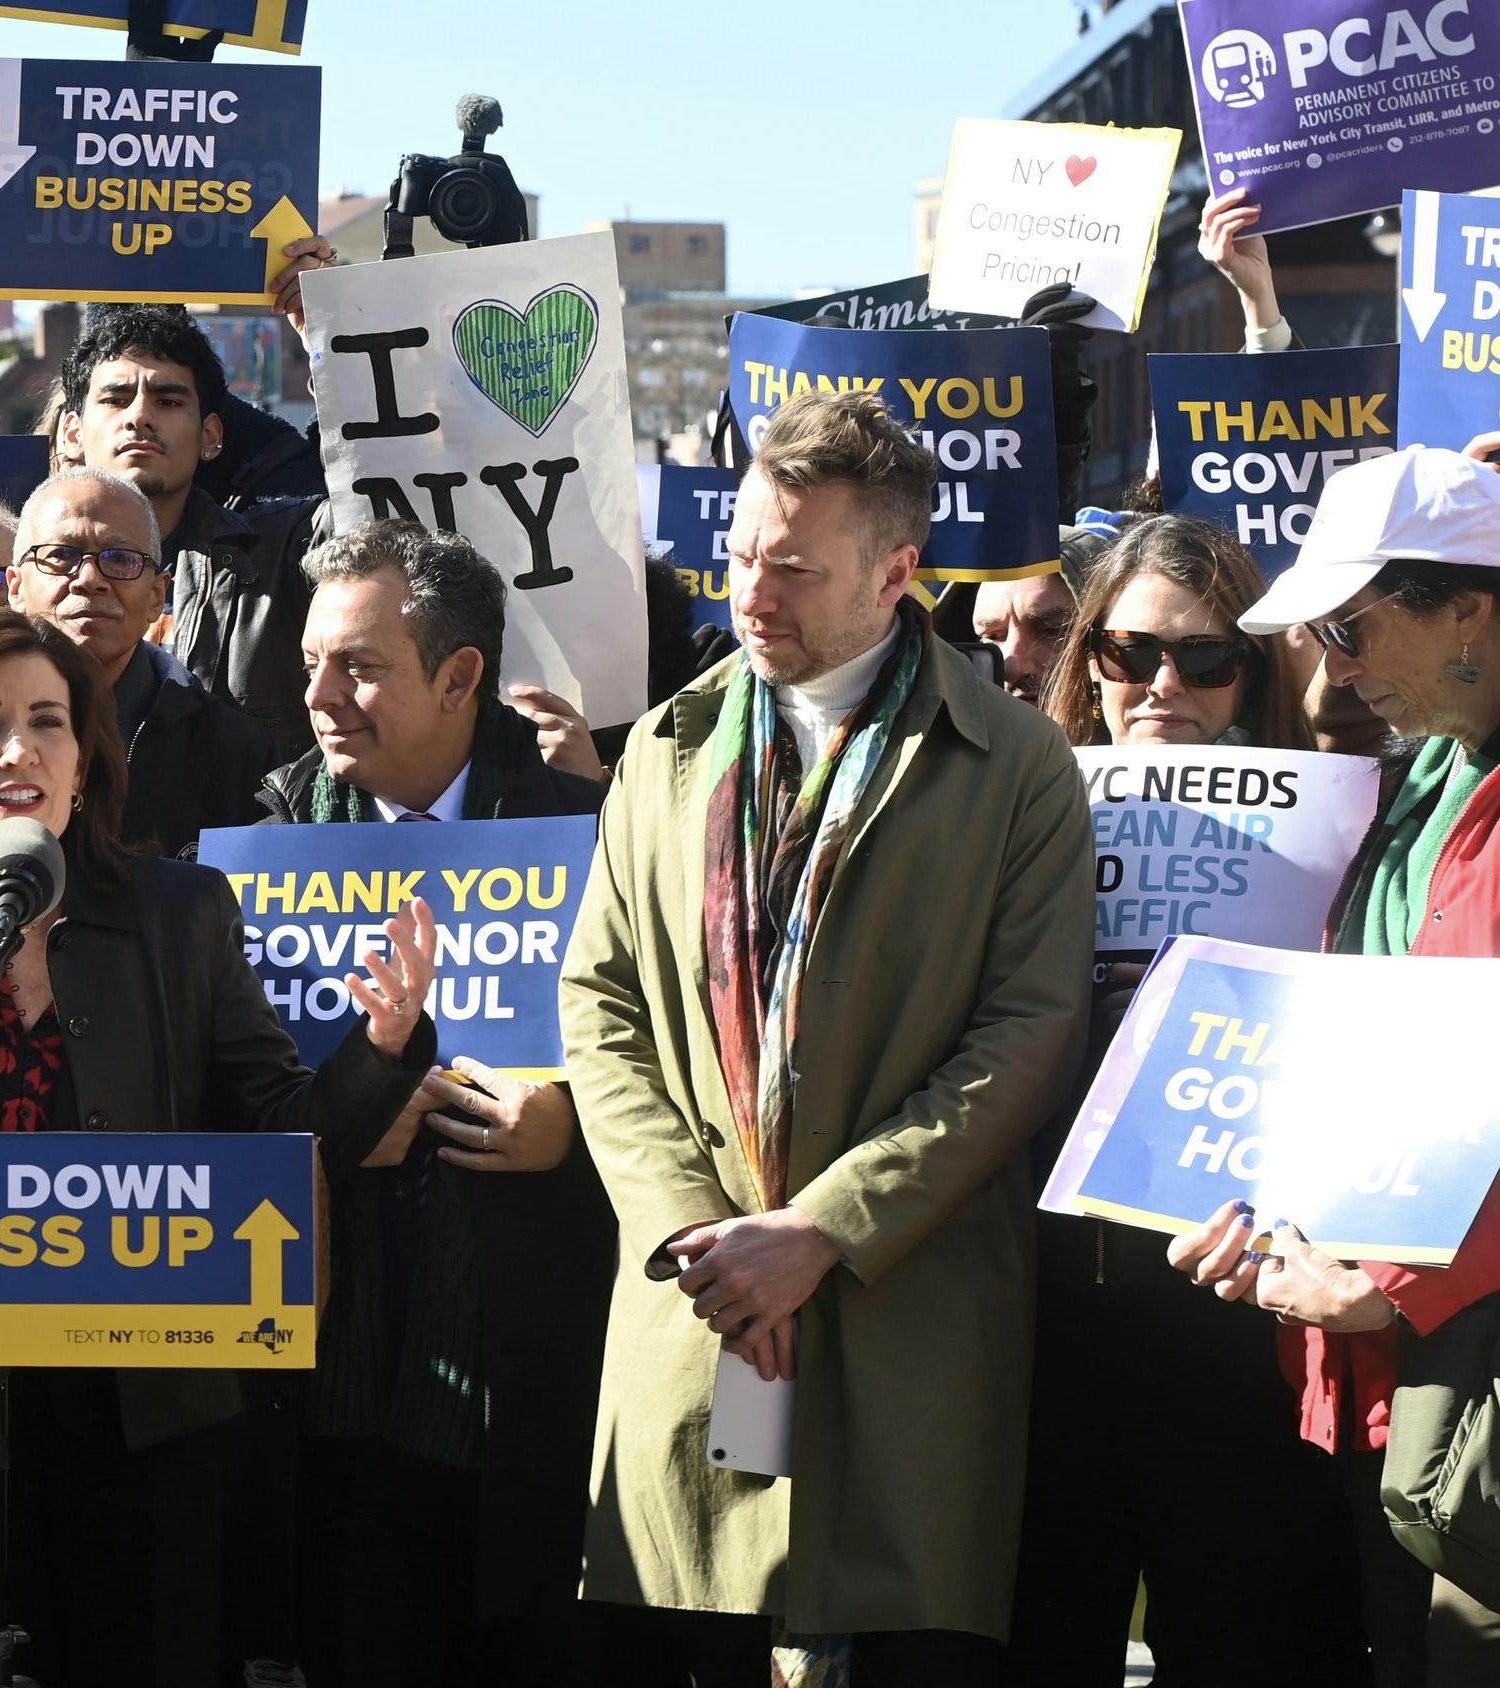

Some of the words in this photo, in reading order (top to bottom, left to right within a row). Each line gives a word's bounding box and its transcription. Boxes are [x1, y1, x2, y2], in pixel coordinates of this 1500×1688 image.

[1283, 0, 1476, 89] PCAC
[56, 86, 239, 124] TRAFFIC
[1295, 81, 1387, 112] PERMANENT
[1392, 65, 1461, 92] CITIZENS
[1299, 103, 1372, 130] ADVISORY
[1378, 82, 1469, 113] COMMITTEE
[1472, 75, 1495, 92] TO
[75, 134, 215, 168] DOWN
[1213, 151, 1234, 165] The
[1235, 146, 1263, 161] voice
[1264, 141, 1282, 156] for
[1283, 138, 1307, 152] New
[1309, 131, 1338, 148] York
[1340, 124, 1362, 142] City
[1441, 105, 1463, 121] and
[1011, 158, 1055, 186] NY
[1237, 160, 1301, 179] www.pcac.org
[35, 176, 252, 215] BUSINESS
[112, 223, 172, 256] UP
[969, 203, 1121, 245] Congestion
[481, 326, 580, 360] Congestion
[331, 327, 439, 440] I
[501, 351, 553, 383] Relief
[511, 385, 549, 405] Zone
[899, 376, 1024, 419] YOU
[1178, 393, 1392, 442] THANK
[1079, 766, 1128, 803] YC
[1141, 766, 1298, 809] NEEDS
[1091, 809, 1178, 848] EAN
[1190, 812, 1274, 853] AIR
[226, 870, 426, 914] THANK
[441, 865, 567, 912] YOU
[1138, 854, 1249, 896] LESS
[243, 920, 560, 968] GOVENOR
[263, 975, 515, 1022] HOUL
[7, 1164, 210, 1209] DOWN
[111, 1215, 214, 1267] UP
[64, 1329, 104, 1343] TEXT
[109, 1329, 133, 1343] NY
[137, 1329, 160, 1343] TO
[164, 1329, 214, 1343] 81336
[276, 1329, 293, 1343] NY
